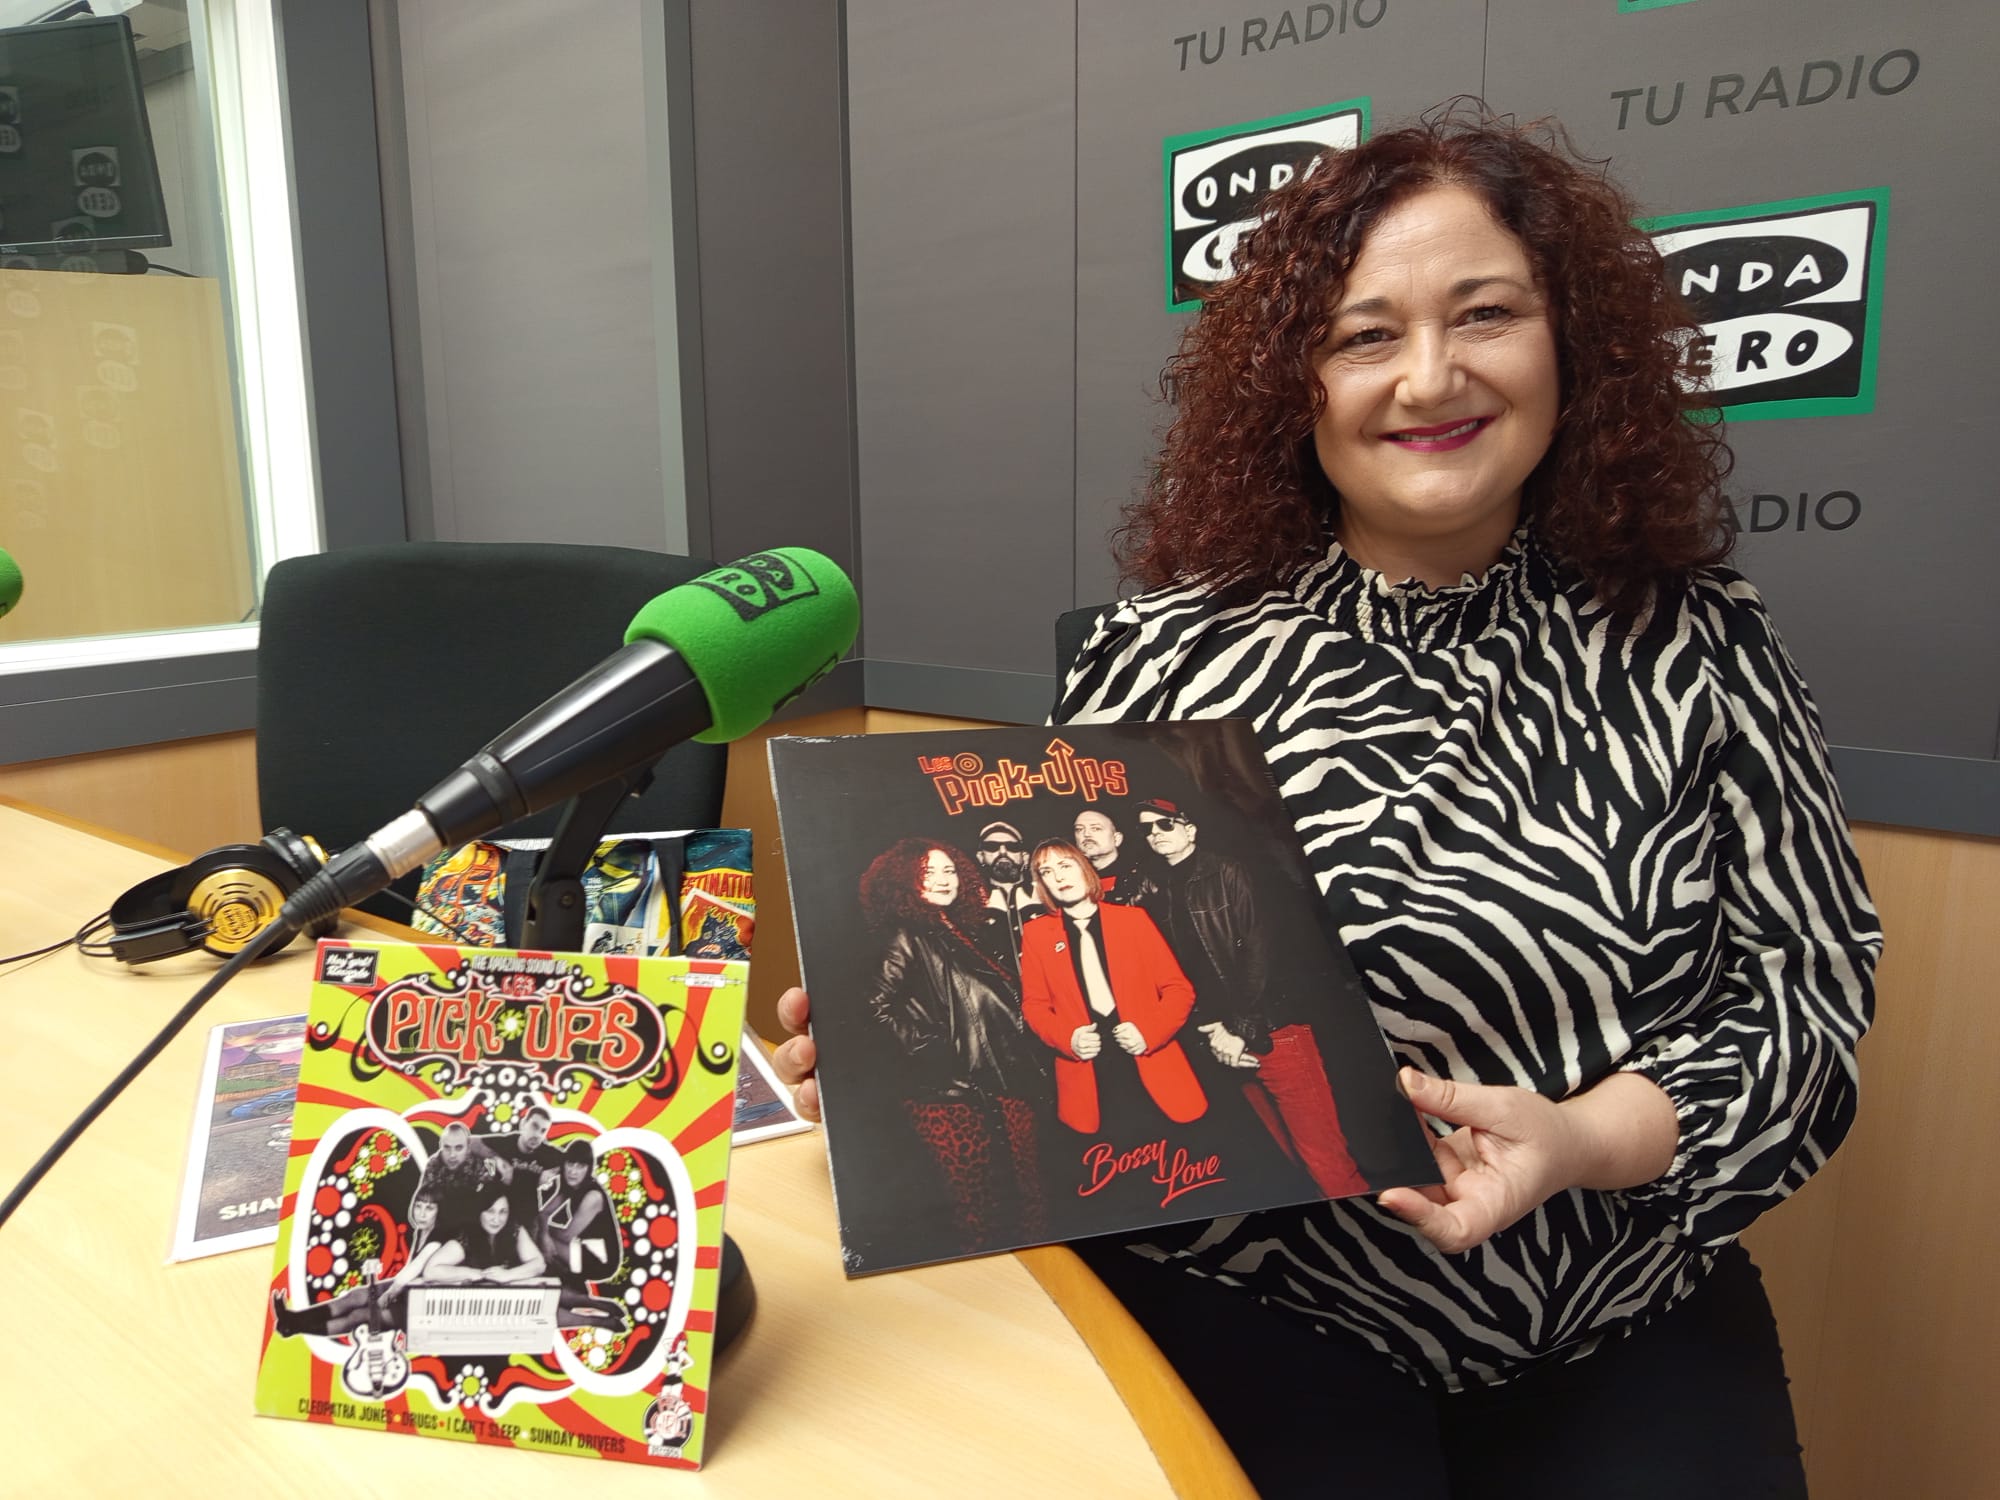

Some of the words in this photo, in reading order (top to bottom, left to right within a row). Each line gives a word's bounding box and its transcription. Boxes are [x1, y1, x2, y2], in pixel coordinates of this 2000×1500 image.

[1174, 26, 1226, 71] TU
[1241, 0, 1388, 56] RADIO
[1610, 82, 1685, 130] TU
[1704, 49, 1920, 119] RADIO
[1681, 254, 1822, 296] NDA
[1686, 329, 1819, 376] ERO
[1718, 490, 1862, 532] ADIO
[384, 988, 504, 1064] PICK
[521, 994, 645, 1072] UPS
[1078, 1138, 1168, 1198] Bossy
[1152, 1147, 1228, 1209] Love
[219, 1195, 284, 1220] SHA
[298, 1398, 356, 1419] CLEOPATRA
[358, 1404, 393, 1425] JONES
[402, 1409, 438, 1430] DRUGS
[454, 1417, 486, 1437] CAN'T
[488, 1420, 521, 1440] SLEEP
[529, 1426, 574, 1448] SUNDAY
[577, 1432, 626, 1454] DRIVERS
